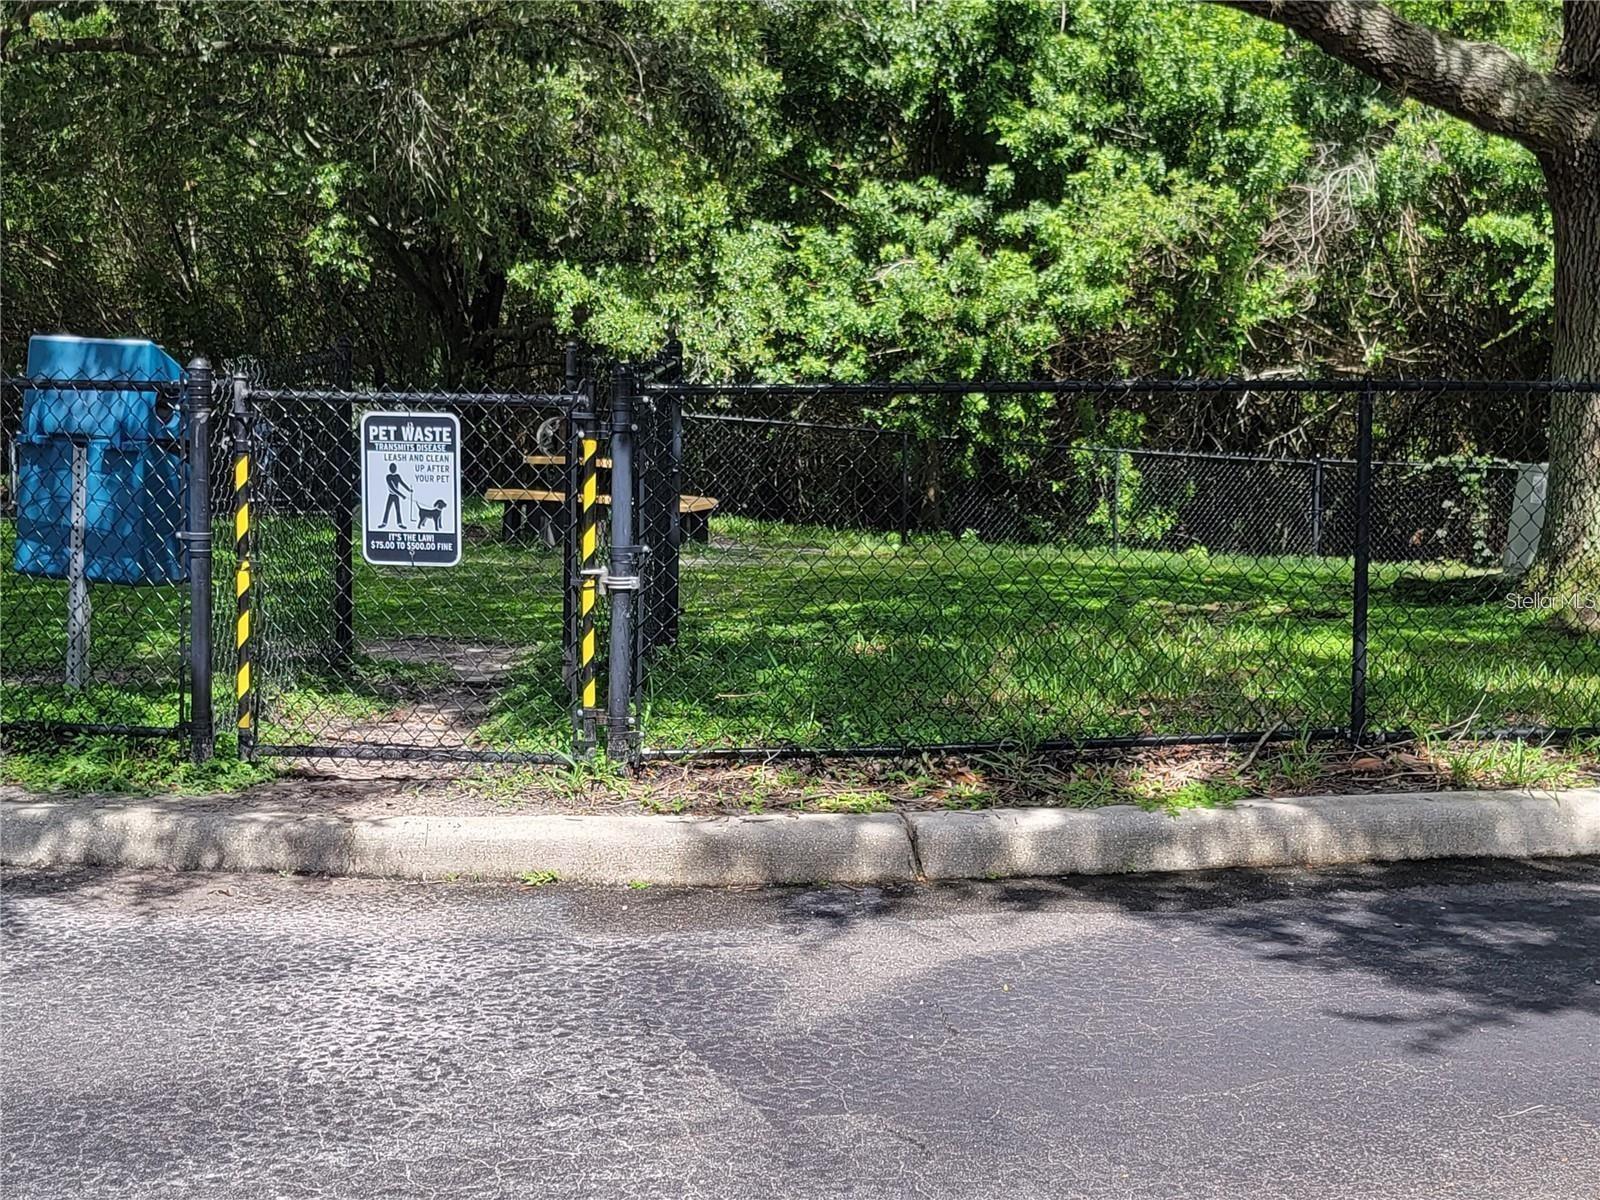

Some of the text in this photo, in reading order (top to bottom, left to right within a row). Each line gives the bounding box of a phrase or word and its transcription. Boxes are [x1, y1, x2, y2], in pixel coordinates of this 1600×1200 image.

[369, 425, 452, 442] PET WASTE
[374, 443, 446, 452] TRANSMITS DISEASE
[384, 453, 407, 461] LEASH
[409, 454, 424, 462] AND
[415, 464, 450, 473] UP AFTER
[415, 475, 450, 483] YOUR PET
[388, 533, 435, 542] IT'S THE LAW!
[370, 540, 453, 551] $75.00 TO $500.00 FINE
